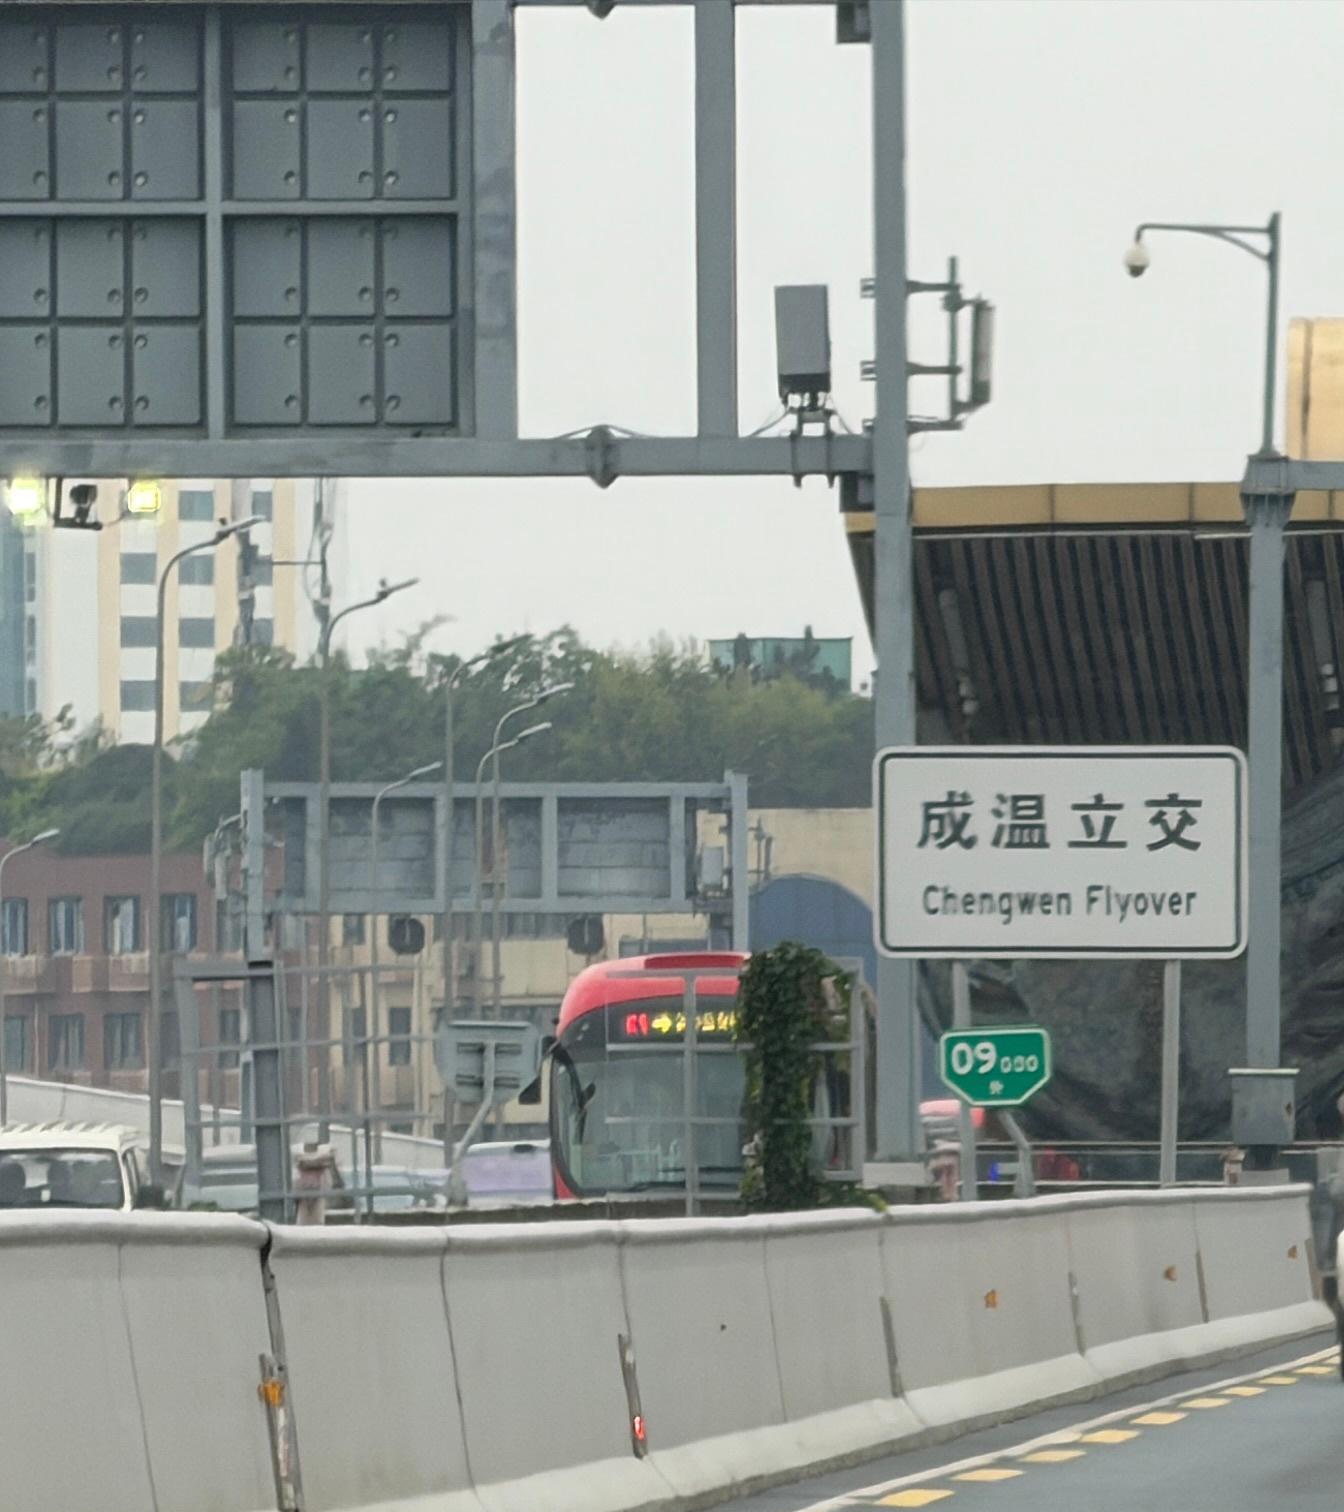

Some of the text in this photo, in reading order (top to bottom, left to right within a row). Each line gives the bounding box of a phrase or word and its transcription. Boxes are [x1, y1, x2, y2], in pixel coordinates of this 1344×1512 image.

[916, 789, 1203, 853] 成温立交
[922, 884, 1198, 925] Chengwen Flyover
